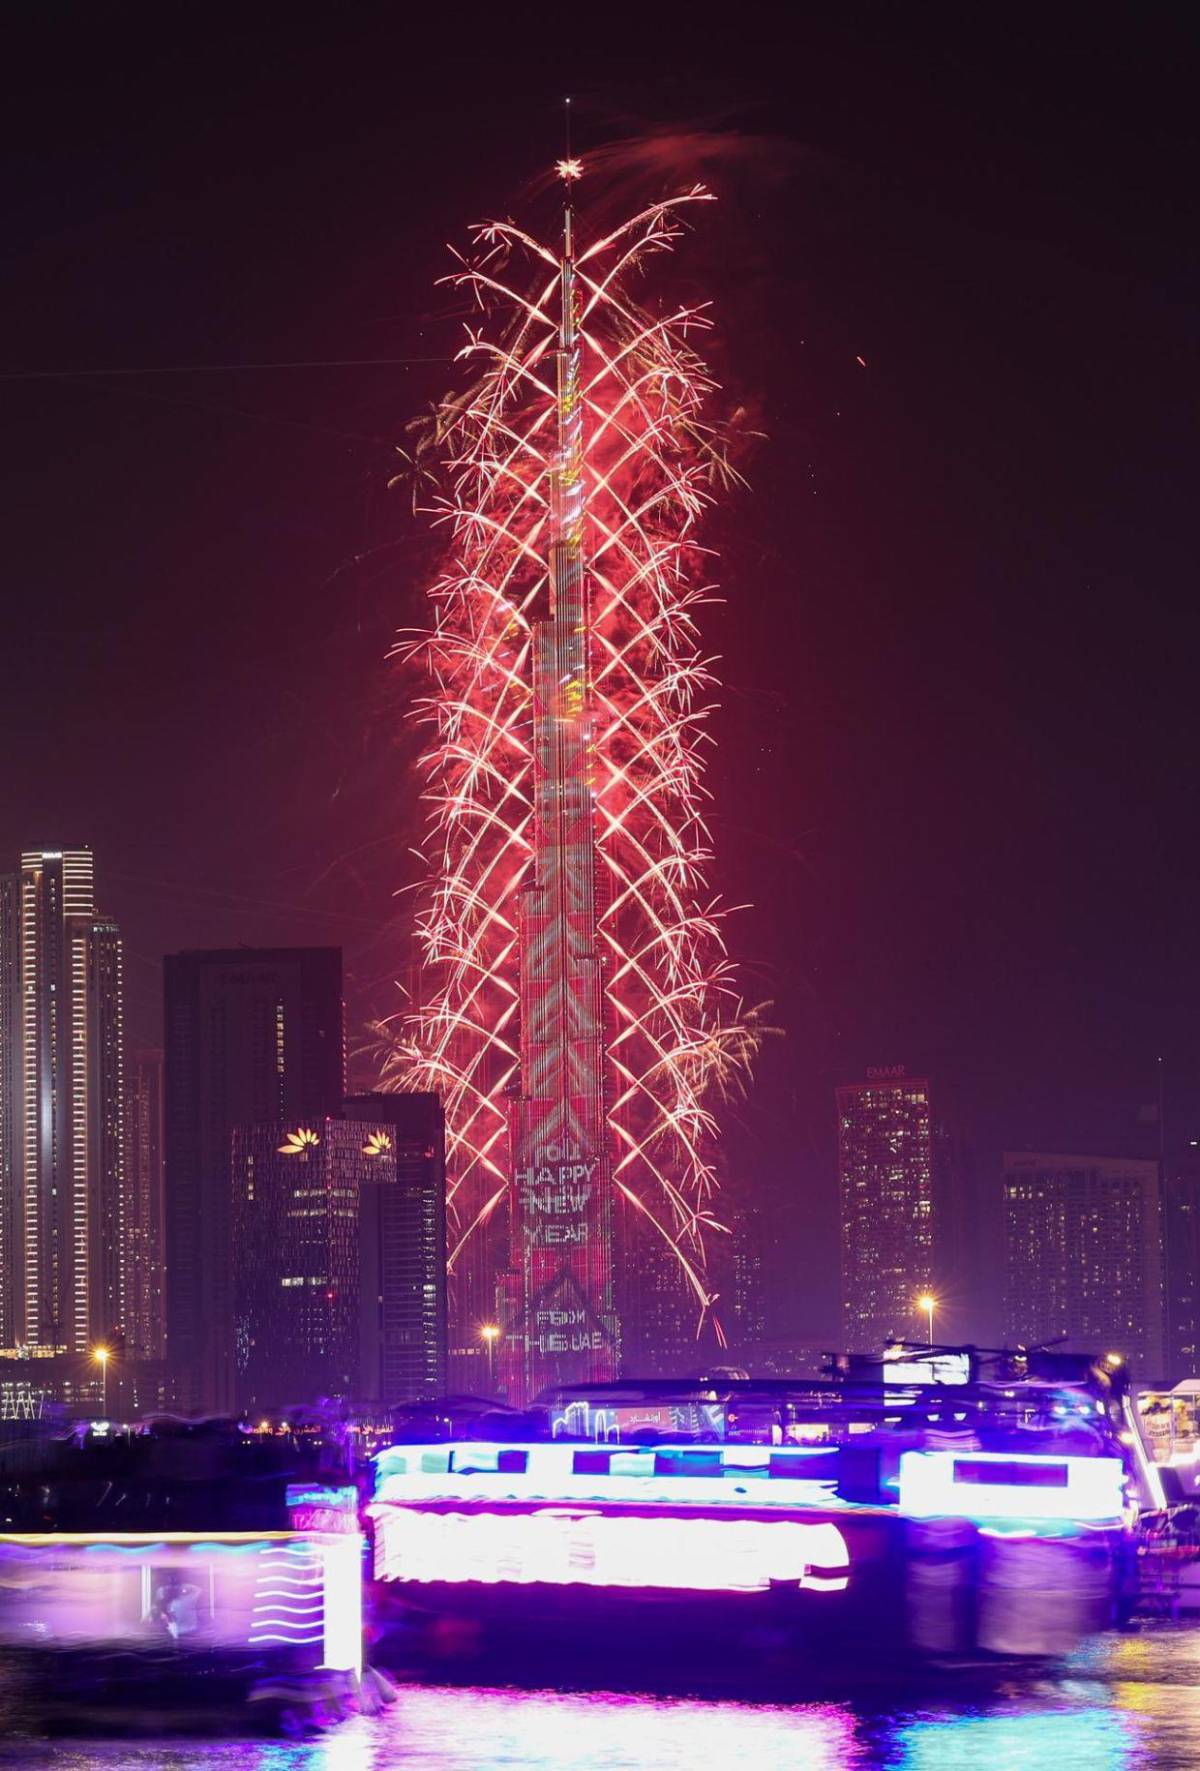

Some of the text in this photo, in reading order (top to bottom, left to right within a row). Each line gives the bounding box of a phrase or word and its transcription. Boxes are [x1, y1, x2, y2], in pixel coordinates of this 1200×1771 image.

[514, 1164, 597, 1186] HAPPY
[529, 1194, 588, 1214] NEW
[522, 1221, 589, 1244] YEAR
[505, 1330, 602, 1353] THE UAE
